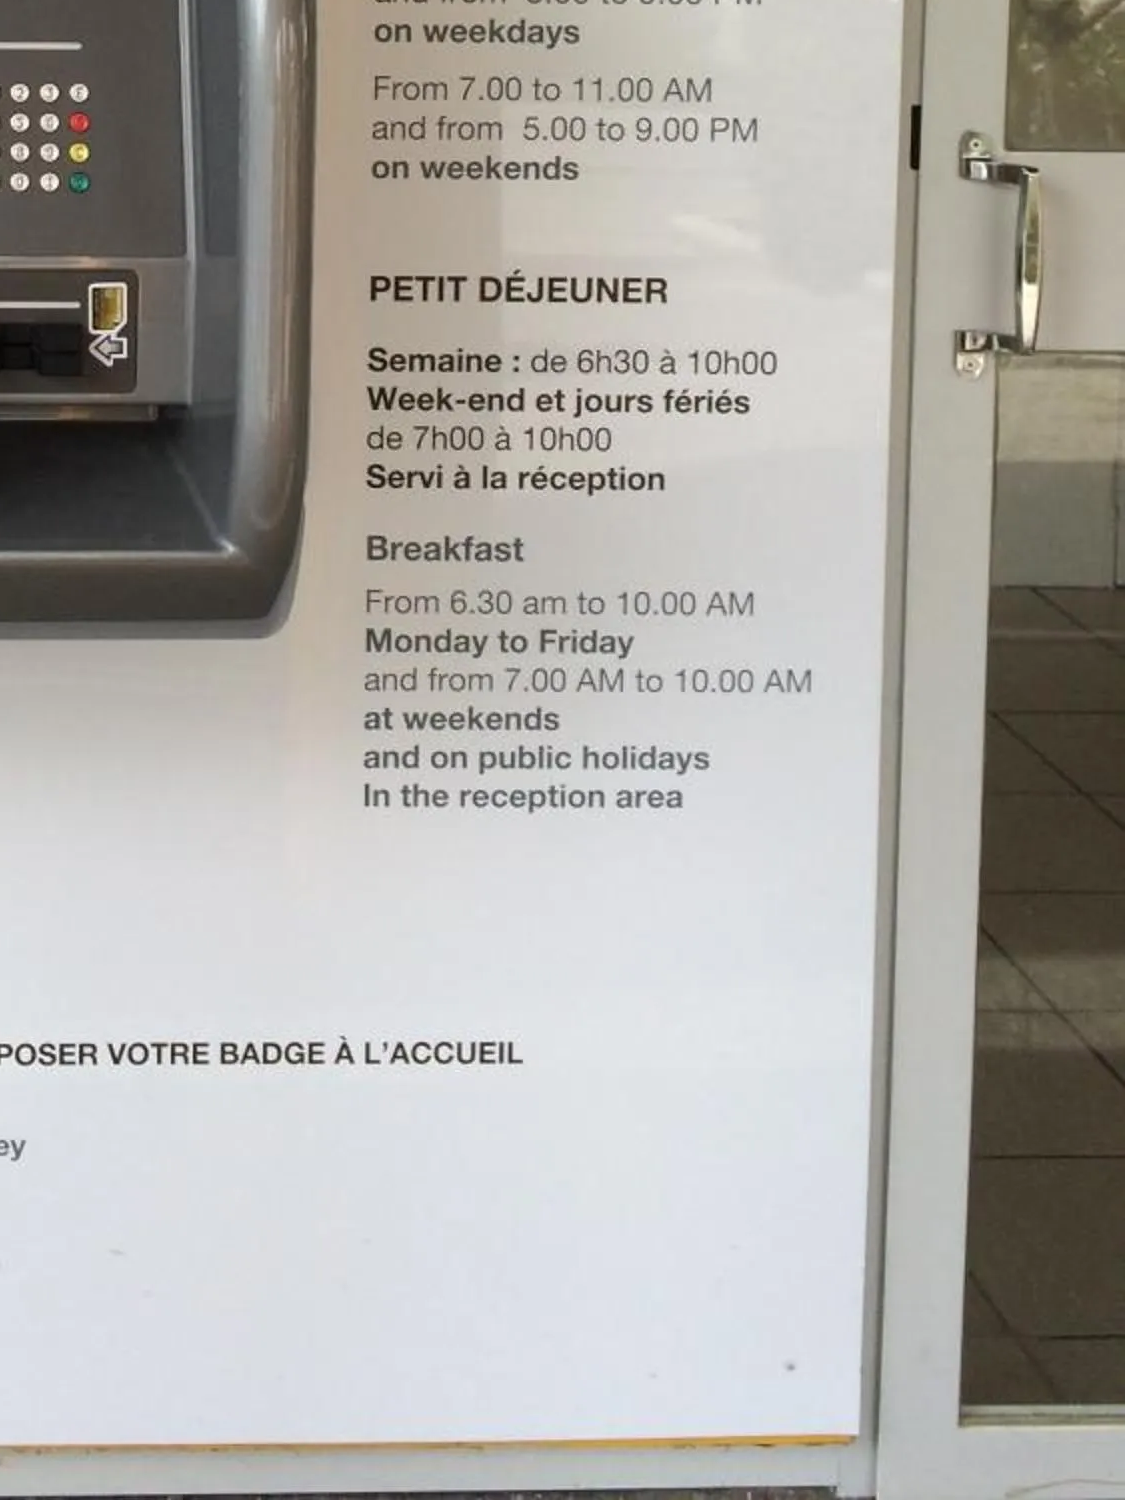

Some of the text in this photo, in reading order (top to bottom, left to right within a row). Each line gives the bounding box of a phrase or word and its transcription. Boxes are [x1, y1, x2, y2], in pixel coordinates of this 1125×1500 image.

[373, 16, 581, 51] on weekdays
[373, 74, 713, 104] From 7.00 to 11.00 AM
[371, 115, 759, 144] and from 5.00 to 9.00 PM
[370, 153, 580, 181] on weekends
[369, 268, 668, 305] PETIT DÉJEUNER
[366, 346, 778, 376] Semaine : de 6h30 à 10h00
[366, 385, 751, 419] Week-end et jours fériés
[365, 424, 612, 453] de 7h00 à 10h00
[365, 462, 666, 497] Servi à la réception
[366, 534, 525, 564] Breakfast
[365, 587, 755, 617] From 6.30 am to 10.00 AM
[364, 627, 636, 661] Monday to Friday
[363, 666, 812, 694] and from 7.00 AM to 10.00 AM
[362, 704, 561, 732] at weekends
[362, 743, 711, 777] and on public holidays
[363, 782, 684, 815] In the reception area
[106, 1041, 211, 1067] VOTRE
[219, 1040, 327, 1066] BADGE
[333, 1035, 356, 1066] À
